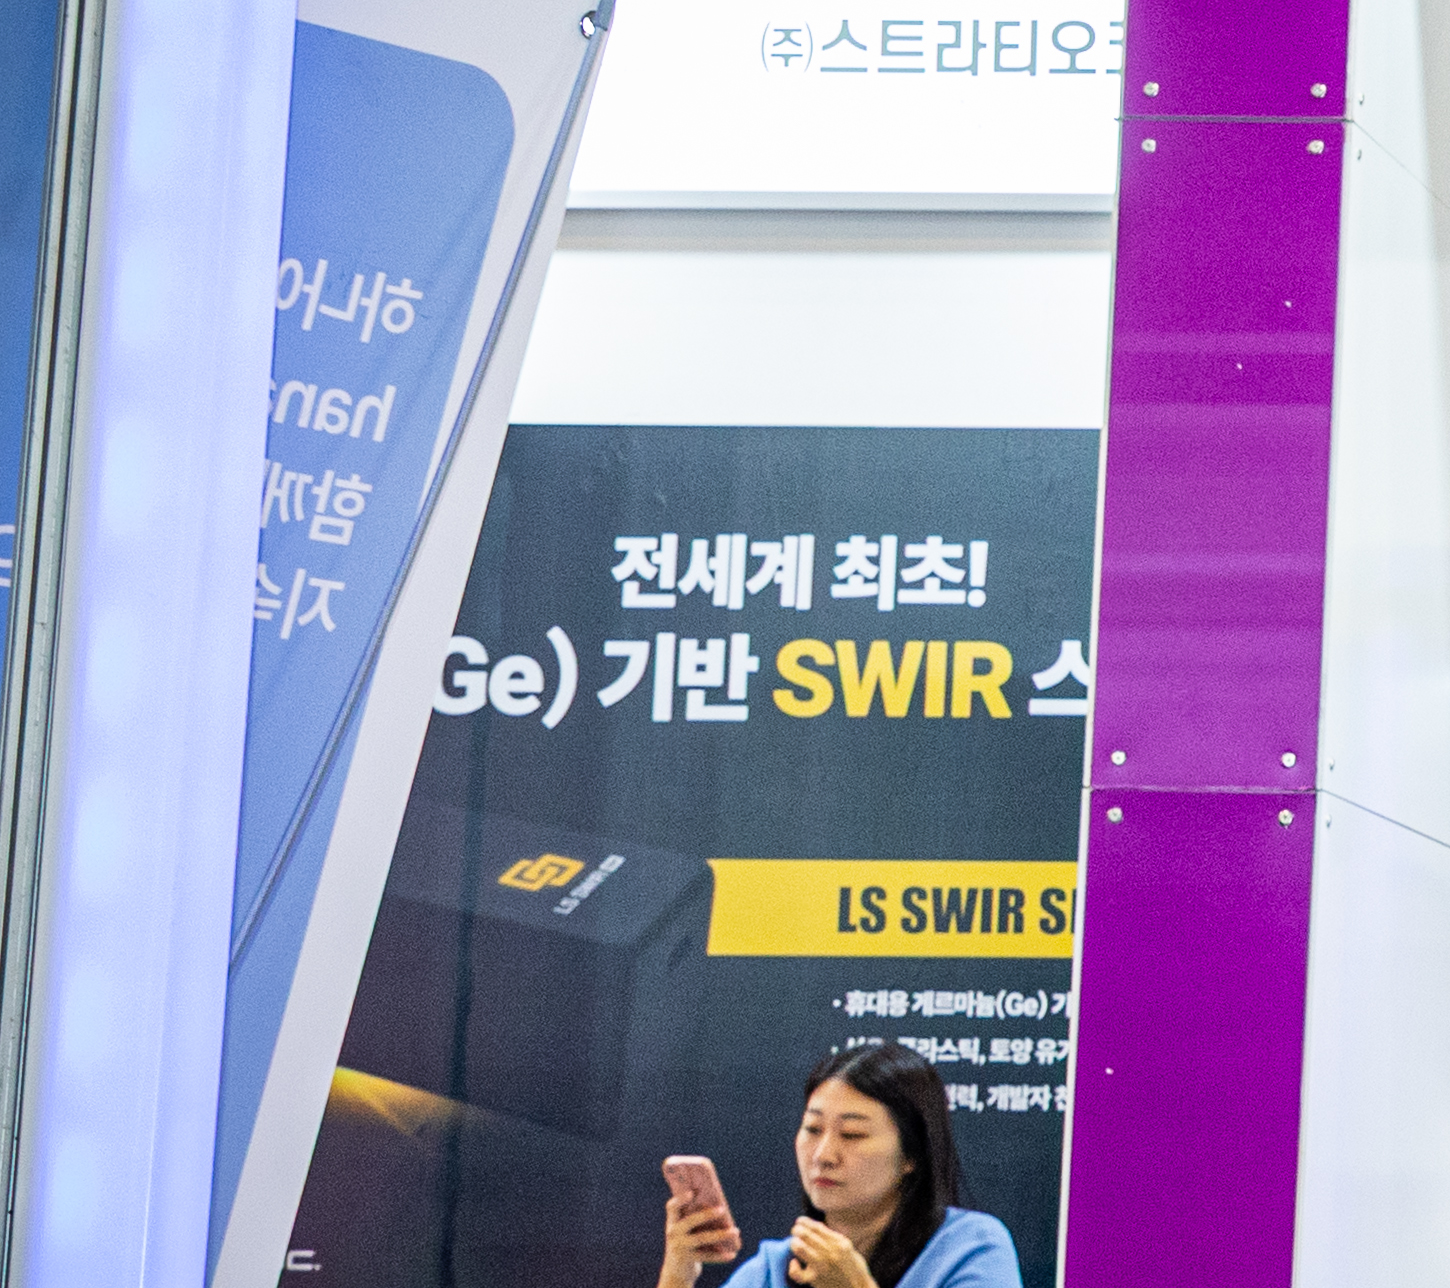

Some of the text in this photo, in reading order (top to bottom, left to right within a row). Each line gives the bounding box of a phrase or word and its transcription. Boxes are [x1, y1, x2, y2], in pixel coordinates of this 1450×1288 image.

[610, 532, 989, 611] 전세계 최초!
[597, 631, 760, 724] 기반
[772, 637, 1014, 720] SWIR
[837, 886, 888, 935] LS
[899, 887, 1026, 936] SWIR
[844, 988, 910, 1018] 휴대용
[988, 1037, 1034, 1065] 토양
